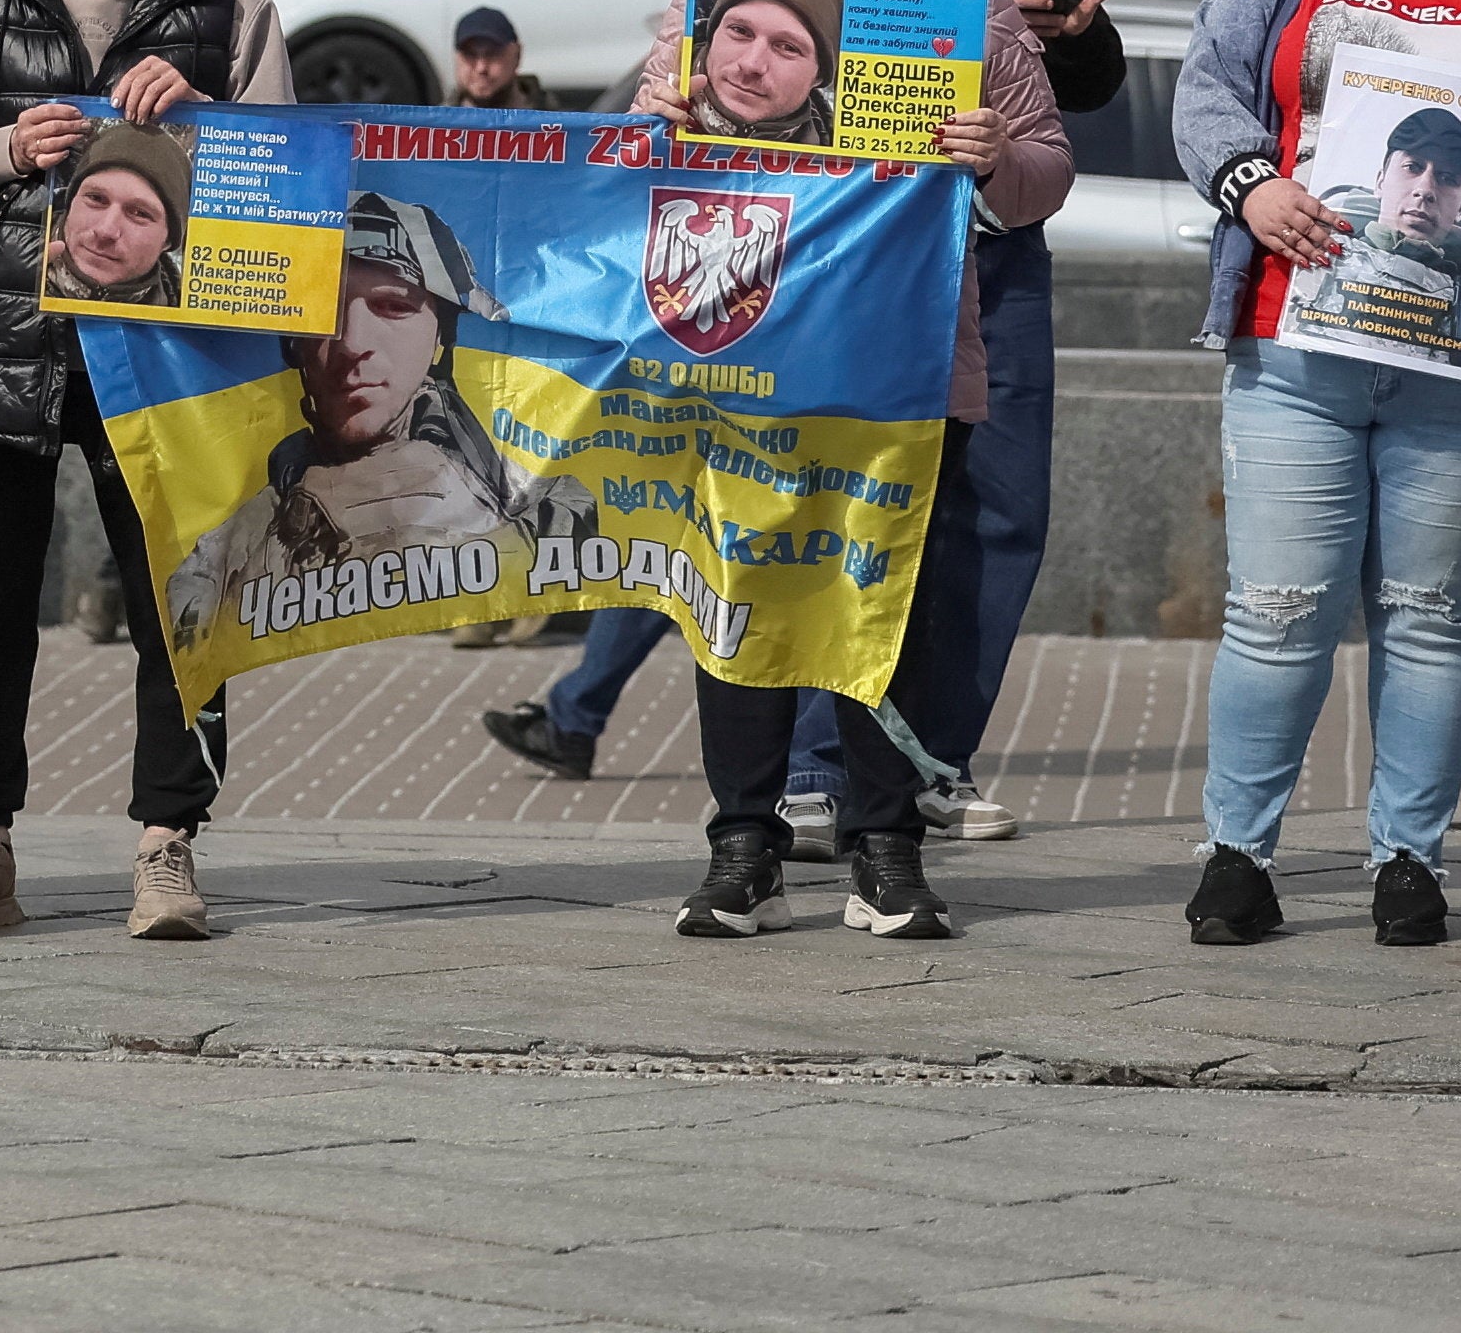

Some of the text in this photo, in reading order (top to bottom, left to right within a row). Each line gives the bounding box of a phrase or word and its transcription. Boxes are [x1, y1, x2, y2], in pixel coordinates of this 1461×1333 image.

[848, 5, 882, 17] кожну
[848, 19, 958, 36] Ти безвісти зниклий
[846, 36, 928, 51] але не забутий
[843, 59, 955, 87] 82 ОДШБр
[842, 76, 956, 101] Макаренко
[1342, 70, 1455, 105] КУЧЕРЕНКО
[841, 93, 956, 120] Олександр
[199, 125, 288, 145] Щодня чекаю
[198, 141, 273, 158] дзвінка або
[196, 170, 269, 188] Що живий і
[194, 186, 281, 204] повернувся...
[192, 200, 344, 225] Де ж ти мій Братику???
[191, 245, 292, 269] 82 ОДШБр
[189, 262, 288, 285] Макаренко
[188, 278, 288, 302] Олександр
[1341, 281, 1450, 312] НАШ РІДНЕНЬКИЙ
[187, 294, 304, 318] Валерійович
[1347, 299, 1435, 327] ПЛЕМІННИЧЕК
[628, 357, 775, 399] 82 ОДШБр
[492, 407, 914, 510] Олександр Валерійович
